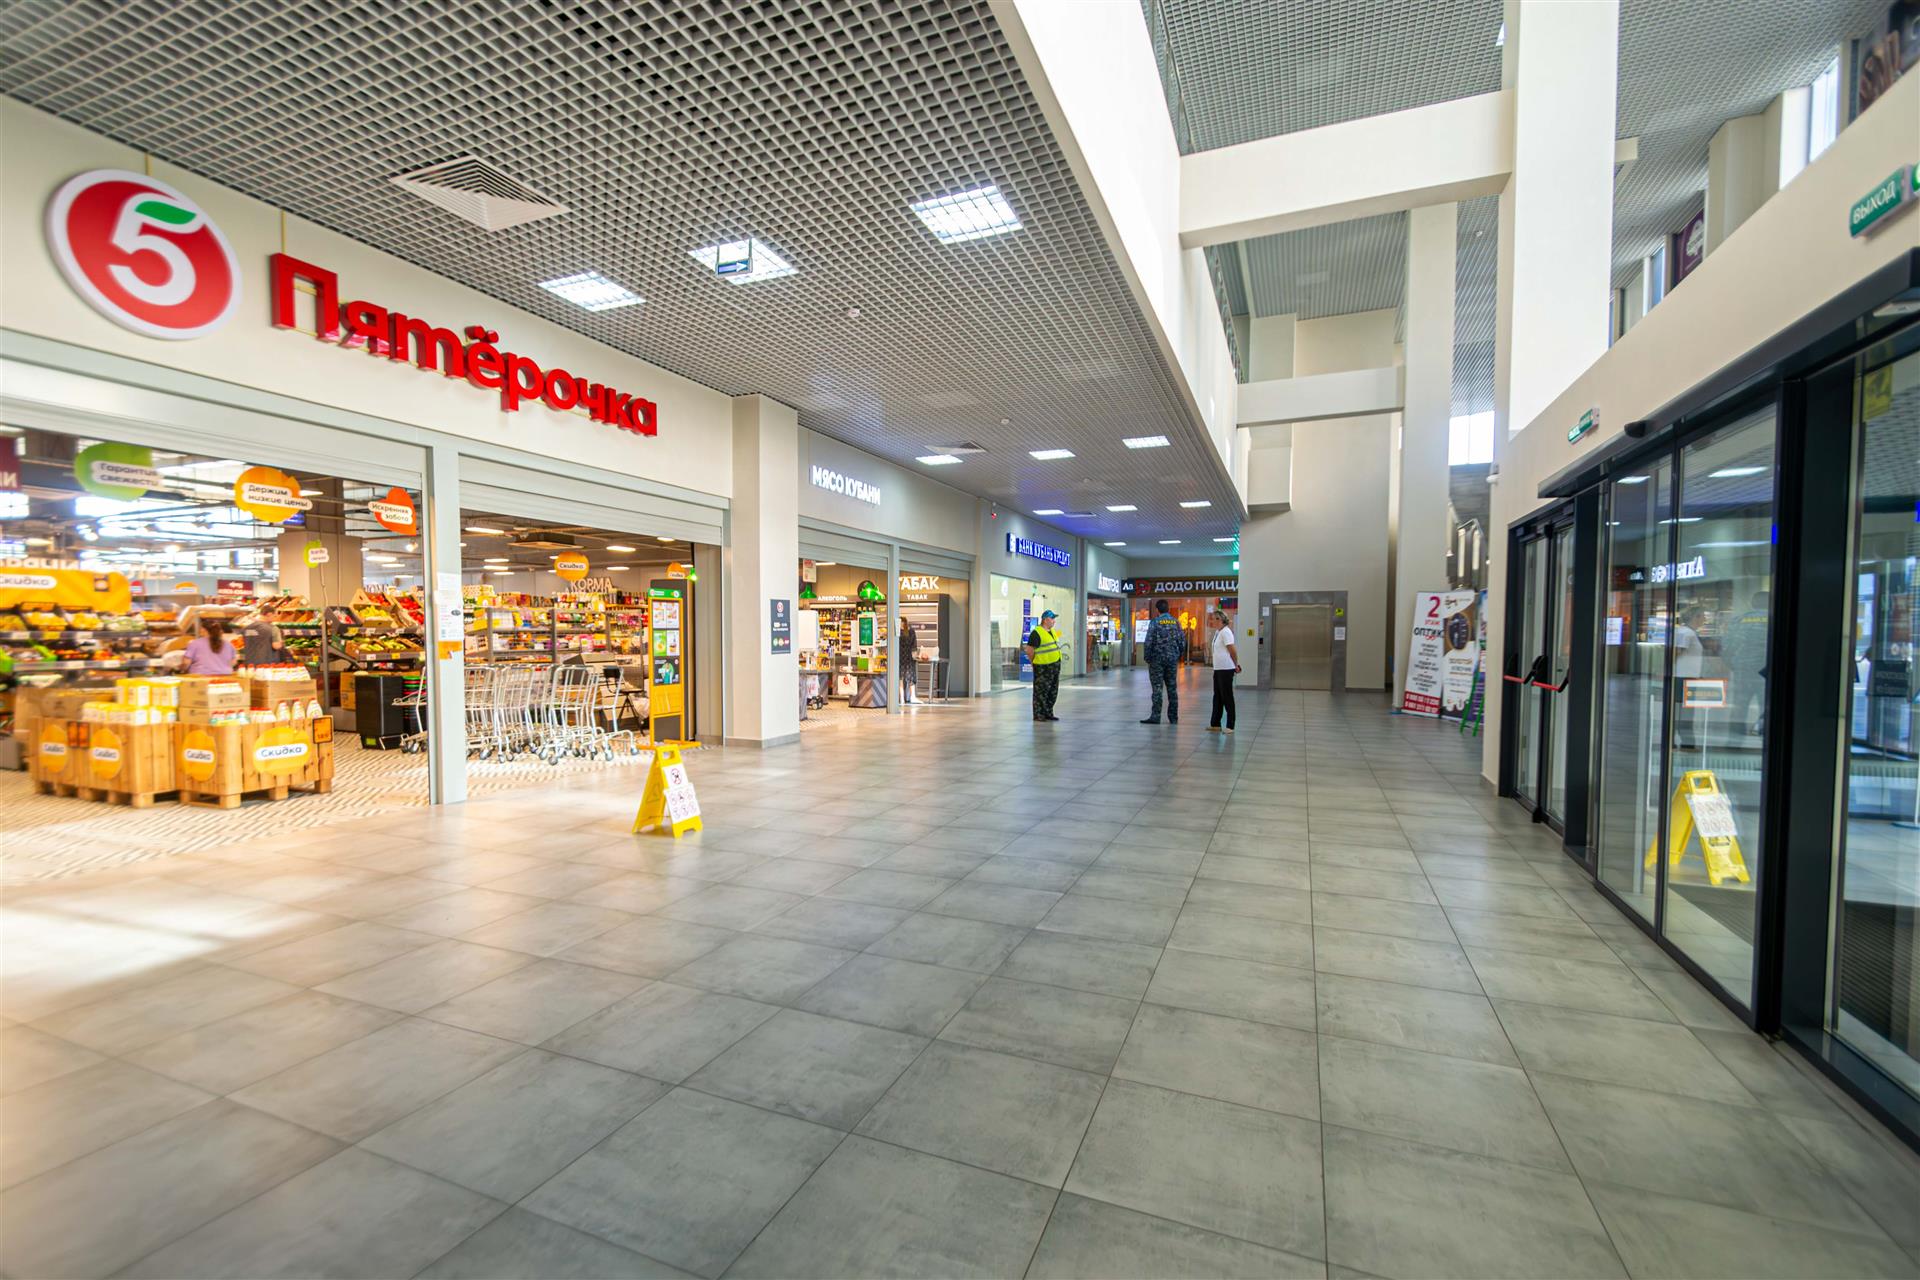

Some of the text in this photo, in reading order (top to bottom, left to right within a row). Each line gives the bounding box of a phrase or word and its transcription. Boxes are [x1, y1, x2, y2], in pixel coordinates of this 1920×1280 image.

[270, 253, 657, 436] Пятёрочка
[100, 463, 157, 476] Гарантия
[248, 484, 288, 496] Держим
[812, 465, 881, 505] МЯСО КУБАНИ
[248, 495, 309, 508] низкие цены
[371, 503, 409, 515] Искренняя
[385, 513, 409, 522] забота
[1018, 537, 1071, 566] БАНК КУБАНЬ КРЕДИТ
[570, 578, 613, 593] КОРМА
[1155, 581, 1193, 593] ДОДО
[1427, 595, 1441, 618] 2
[260, 746, 302, 758] Скидка
